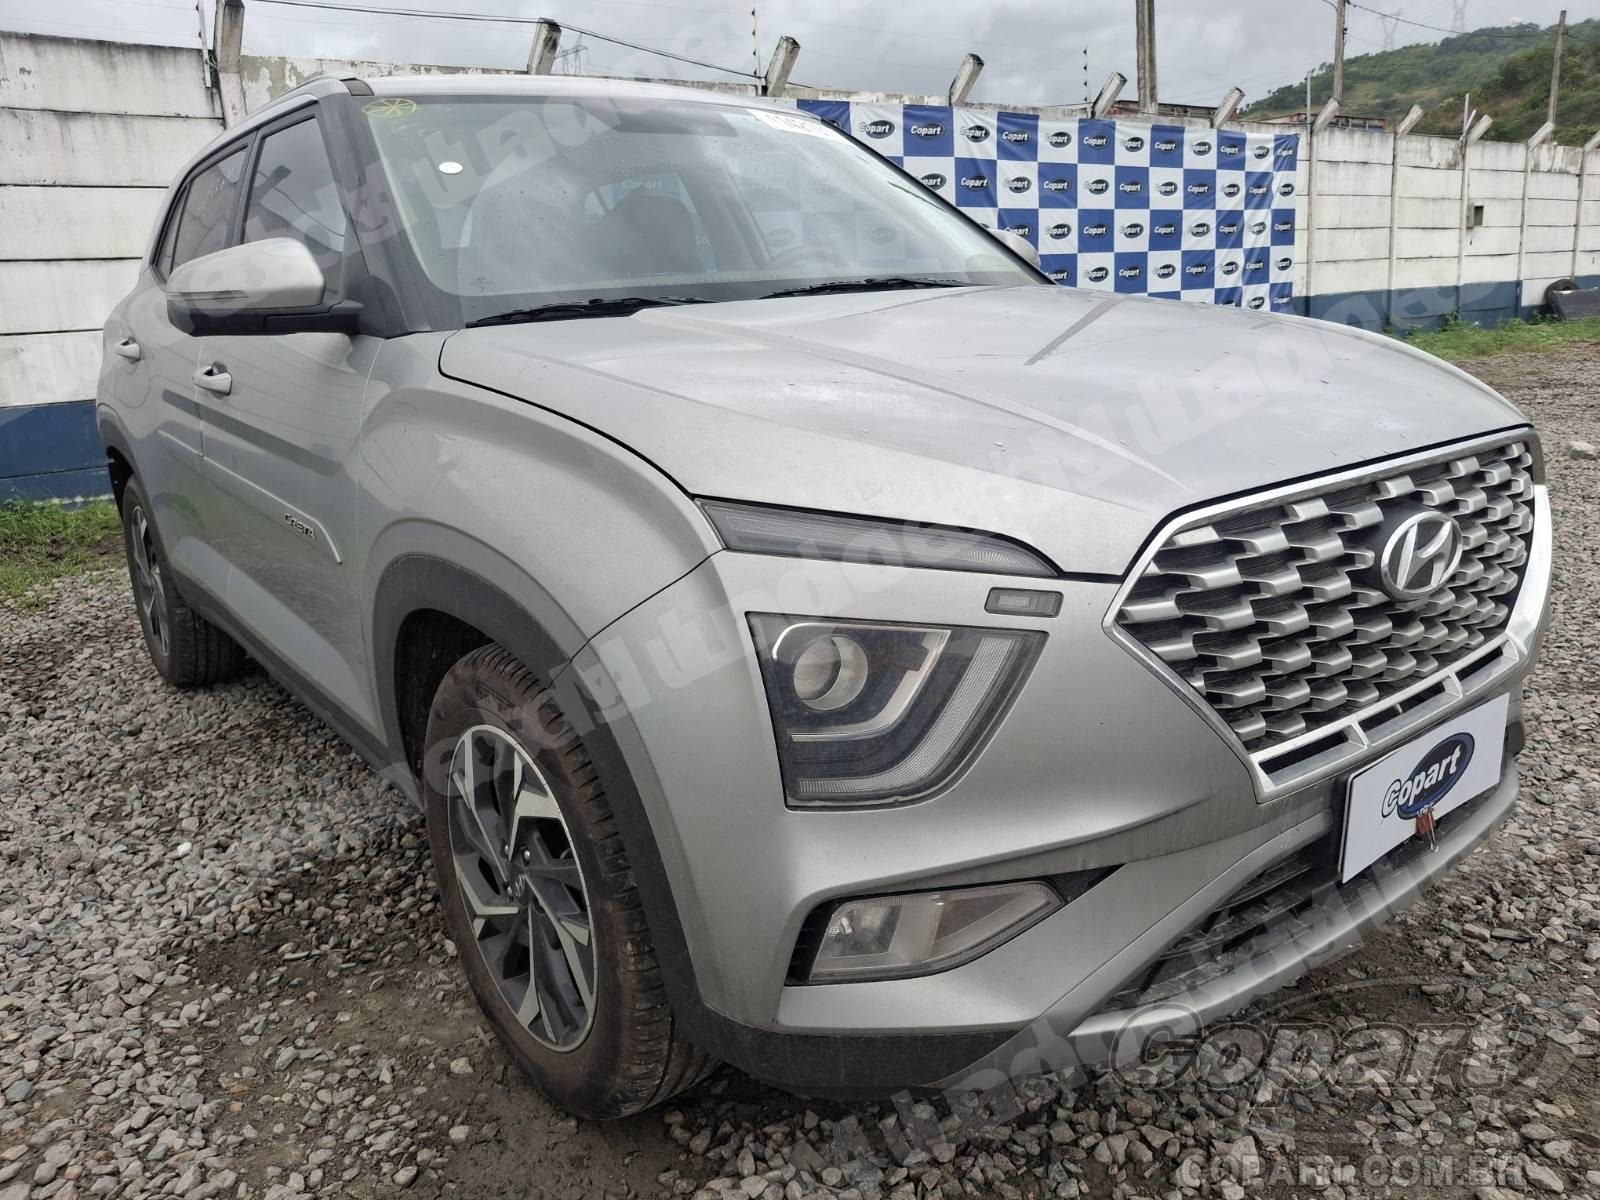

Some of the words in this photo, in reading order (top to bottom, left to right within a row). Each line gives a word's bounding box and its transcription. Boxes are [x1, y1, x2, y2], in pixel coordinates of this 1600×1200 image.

[860, 122, 889, 134] Copart
[911, 125, 941, 136] Copart
[960, 127, 986, 137] Copart
[1002, 131, 1028, 141] Copart
[1044, 133, 1068, 143] Copart
[1083, 136, 1107, 146] Copart
[1154, 141, 1176, 151] Copart
[961, 177, 987, 188] Copart
[1003, 179, 1028, 189] Copart
[1044, 181, 1068, 190] Copart
[1083, 181, 1107, 190] Copart
[1119, 183, 1141, 192] Copart
[1046, 226, 1068, 235] Copart
[1083, 226, 1107, 236] Copart
[1083, 269, 1106, 279] Copart
[1382, 744, 1461, 818] Copart
